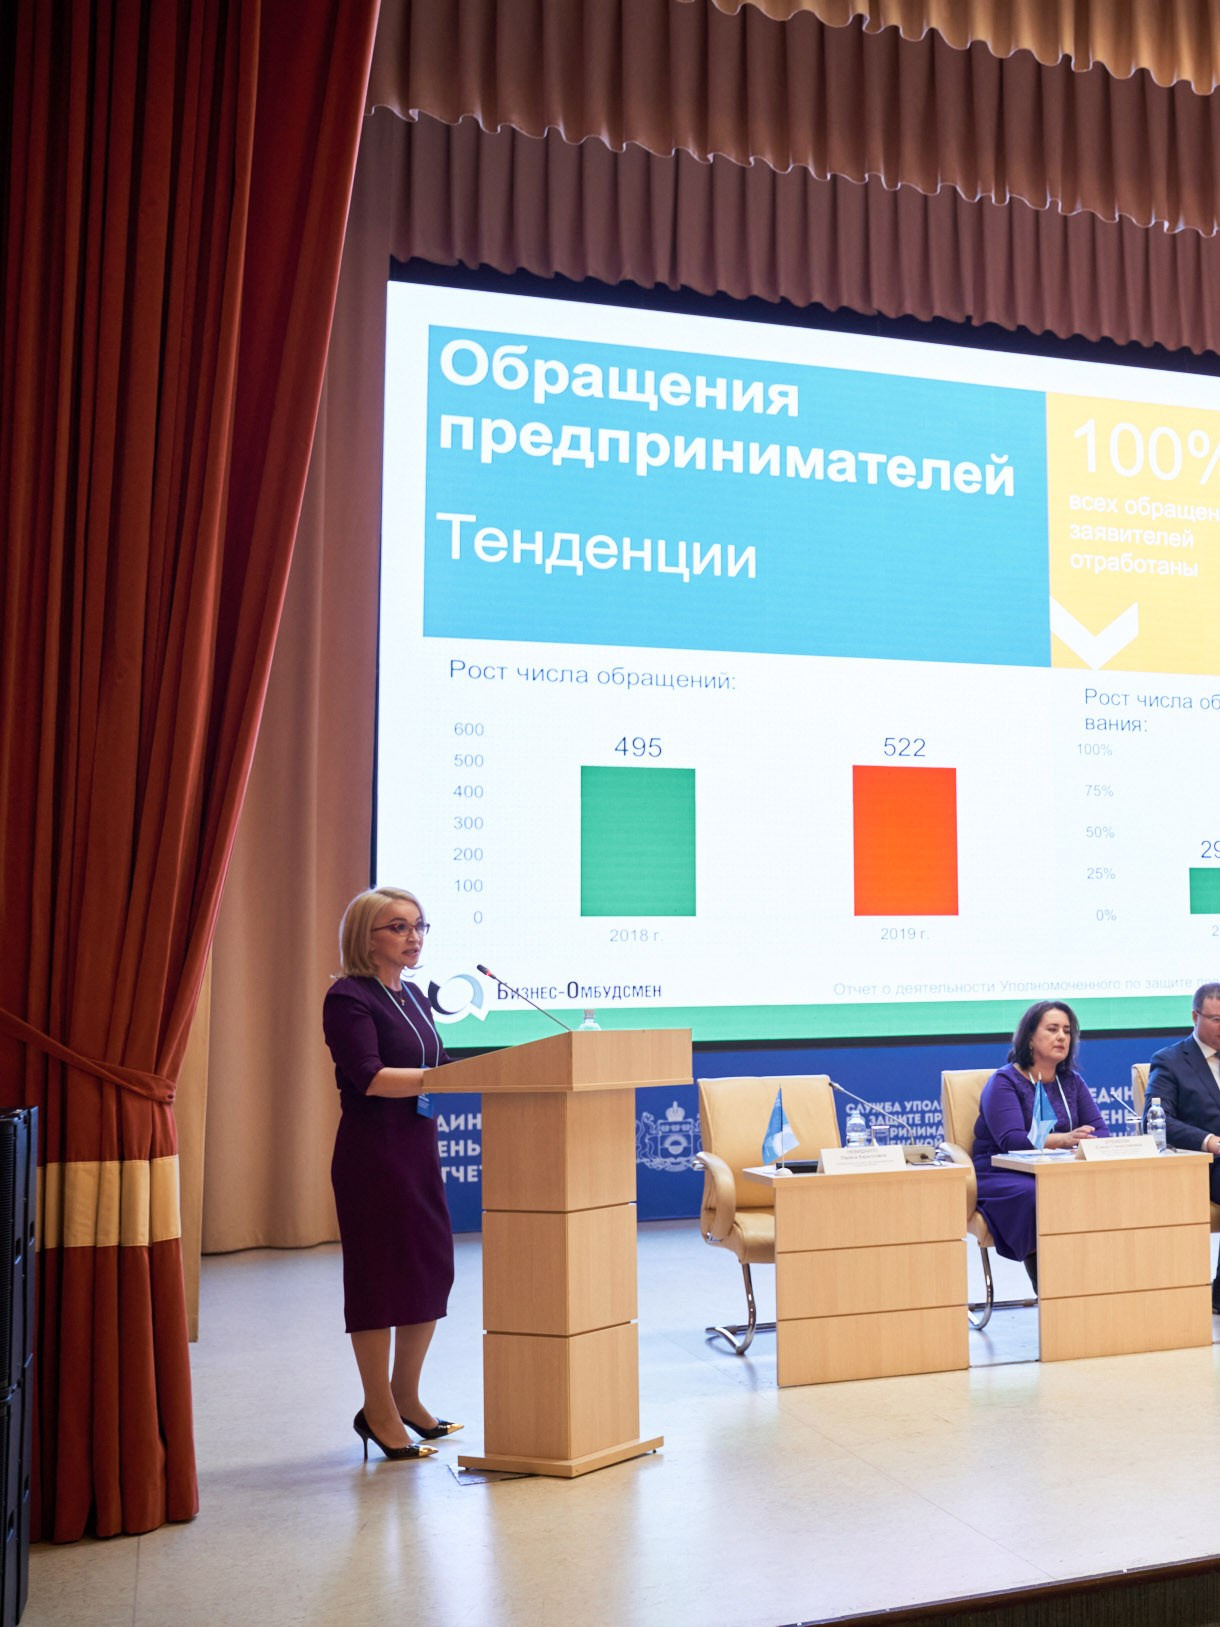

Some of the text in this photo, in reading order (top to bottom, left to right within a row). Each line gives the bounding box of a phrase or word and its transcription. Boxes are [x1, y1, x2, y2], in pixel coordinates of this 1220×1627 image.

[440, 339, 799, 417] Обращения
[439, 413, 1015, 496] предпринимателей
[1069, 494, 1118, 514] всех
[1069, 522, 1195, 548] заявителей
[436, 512, 757, 582] Тенденции
[1070, 553, 1199, 577] отработаны
[449, 660, 737, 690] Рост числа обращений:
[1084, 688, 1131, 709] Рост
[1136, 692, 1193, 711] числа
[454, 722, 484, 736] 600
[1084, 716, 1148, 733] вания:
[614, 736, 663, 758] 495
[883, 736, 926, 758] 522
[1077, 743, 1113, 757] 100%
[454, 754, 484, 768] 500
[452, 785, 484, 799] 400
[1085, 784, 1114, 797] 75%
[452, 816, 484, 830] 300
[1085, 826, 1115, 839] 50%
[452, 847, 484, 861] 200
[1087, 868, 1116, 880] 25%
[454, 878, 484, 892] 100
[473, 910, 484, 924] 0
[1096, 909, 1117, 921] 0%
[609, 928, 649, 943] 2018
[880, 927, 916, 941] 2019
[833, 982, 876, 996] Отчет
[882, 984, 891, 994] о
[895, 983, 995, 996] деятельности
[1000, 978, 1121, 993] Уполномоченного
[1126, 980, 1141, 990] по
[1145, 977, 1192, 992] защите
[441, 1165, 482, 1183] ТЧЕ
